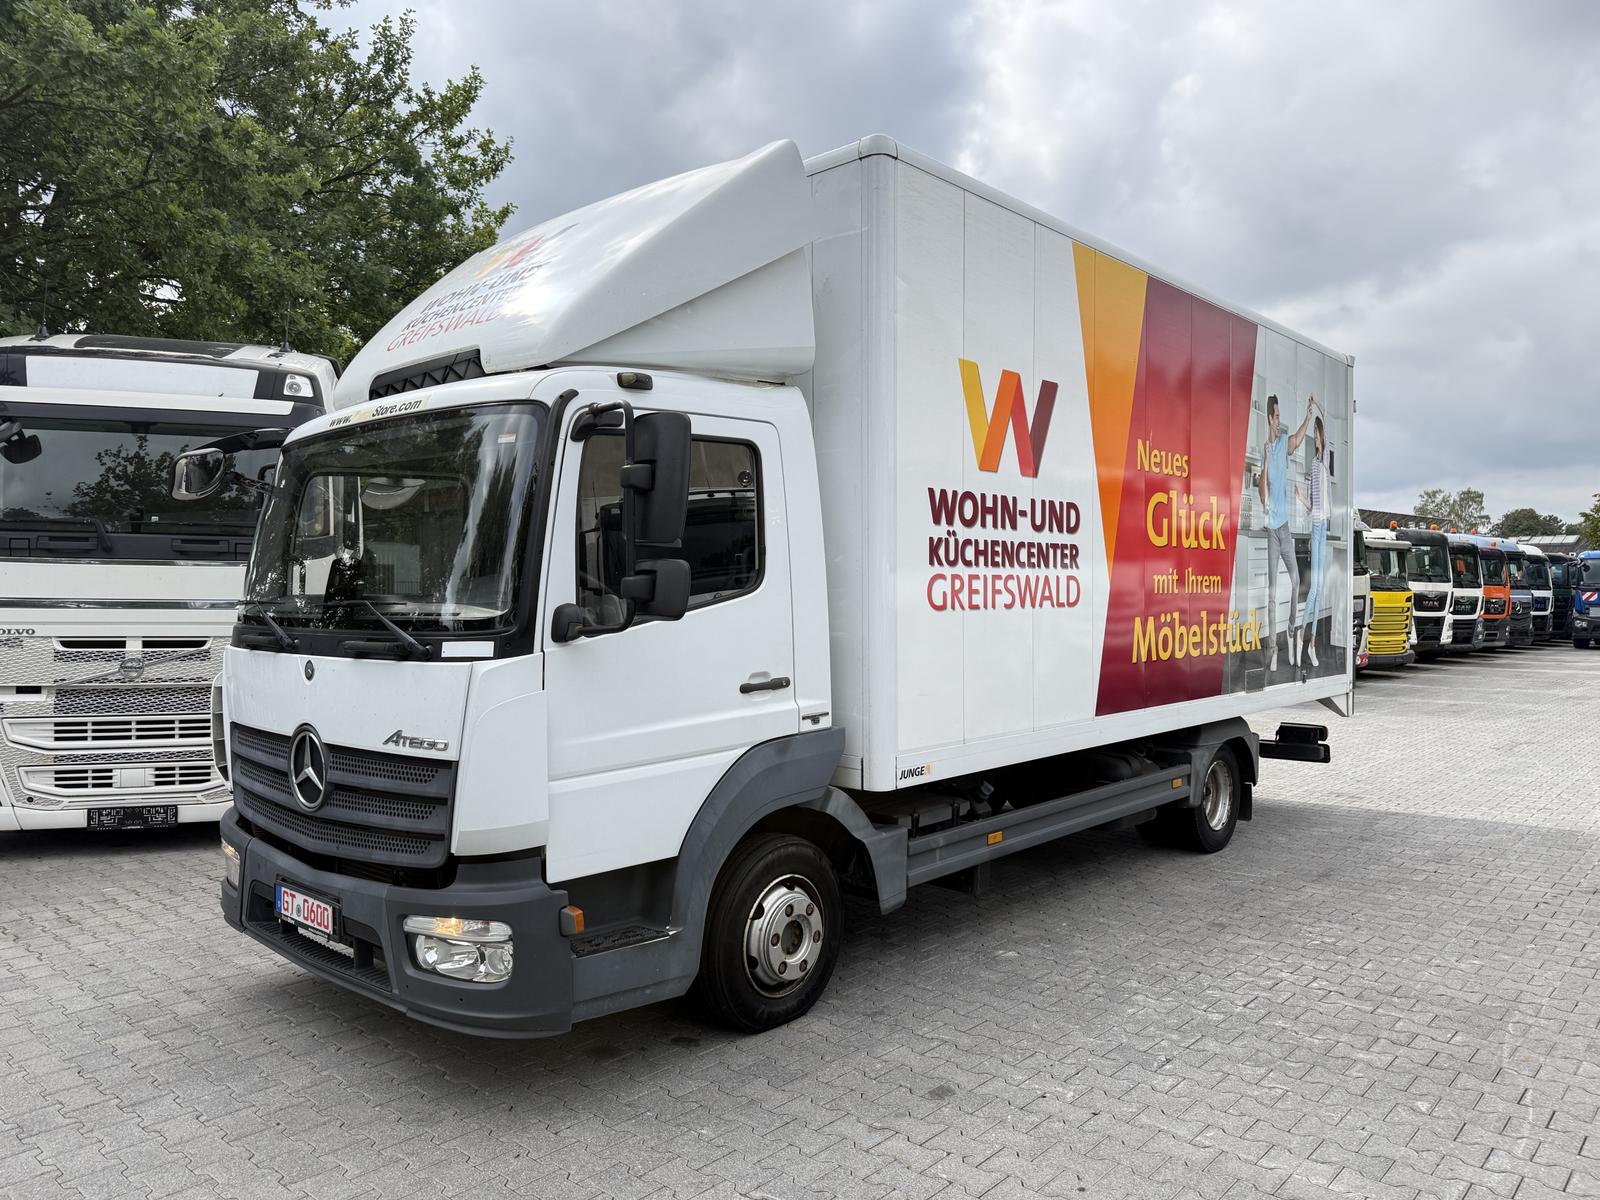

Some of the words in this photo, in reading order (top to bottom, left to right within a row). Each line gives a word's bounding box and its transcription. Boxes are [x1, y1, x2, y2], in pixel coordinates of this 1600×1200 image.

[1137, 438, 1189, 478] Neues
[928, 487, 1081, 535] WOHN-UND
[1146, 489, 1227, 550] Glück
[928, 530, 1080, 569] KÜCHENCENTER
[927, 573, 1081, 611] GREIFSWALD
[1153, 567, 1179, 594] mit
[1185, 566, 1223, 594] Ihrem
[1131, 607, 1262, 664] Möbelstück
[899, 766, 926, 781] JUNGE
[282, 889, 297, 915] GT
